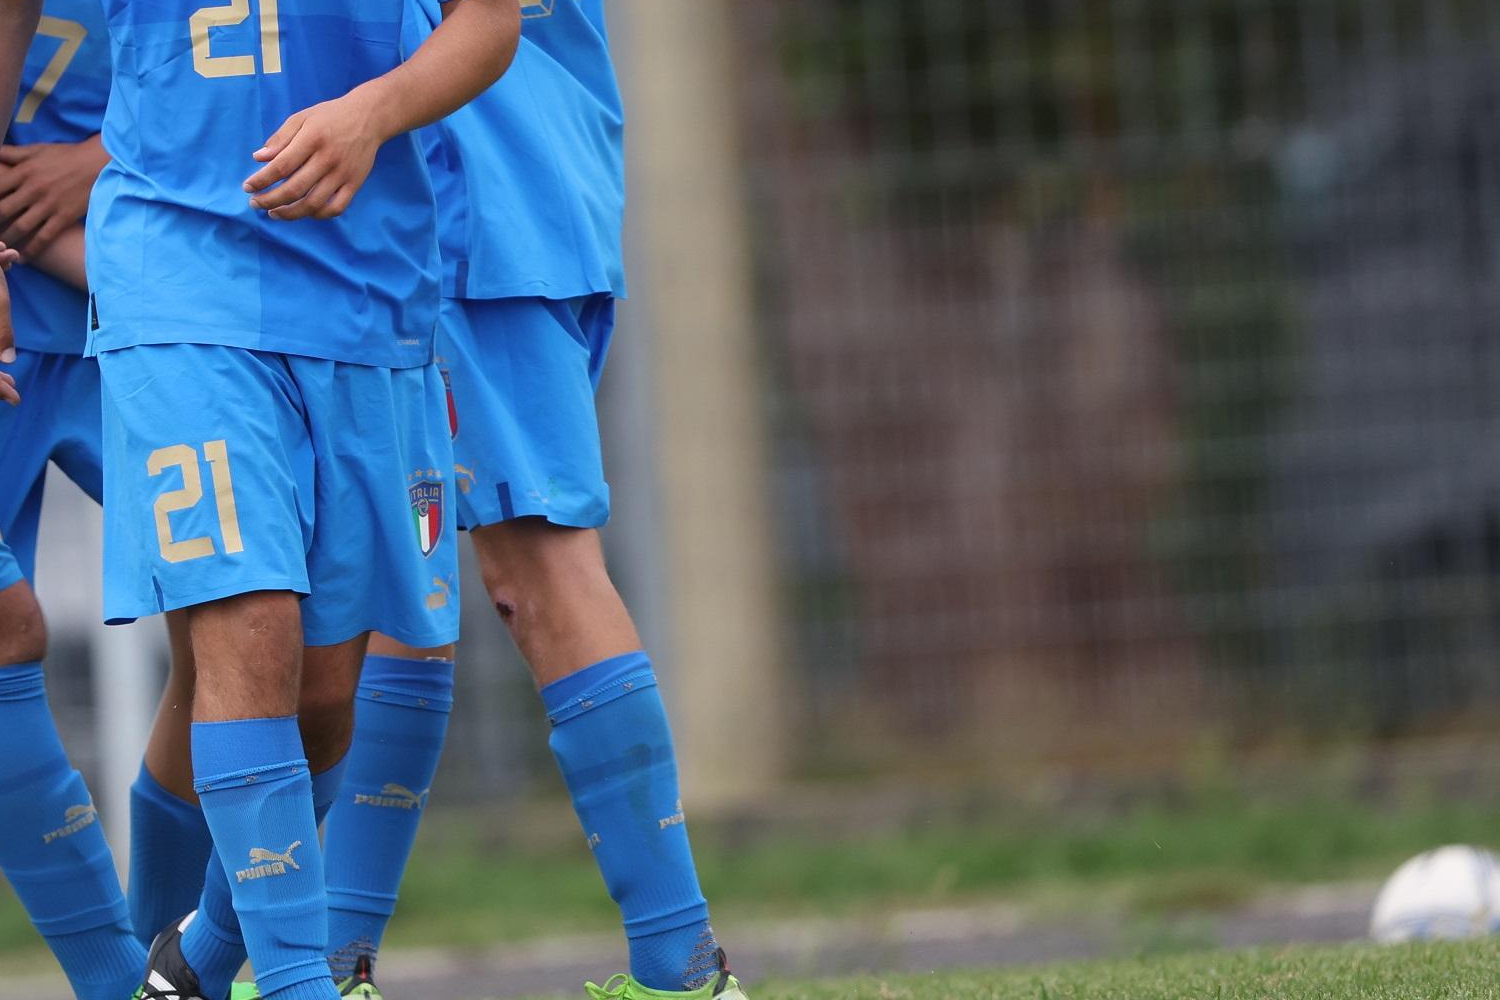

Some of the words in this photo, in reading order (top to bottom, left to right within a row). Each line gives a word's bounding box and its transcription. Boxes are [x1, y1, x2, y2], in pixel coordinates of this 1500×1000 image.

[146, 439, 245, 563] 21
[410, 486, 439, 501] ITALIA
[236, 862, 286, 882] PUMA
